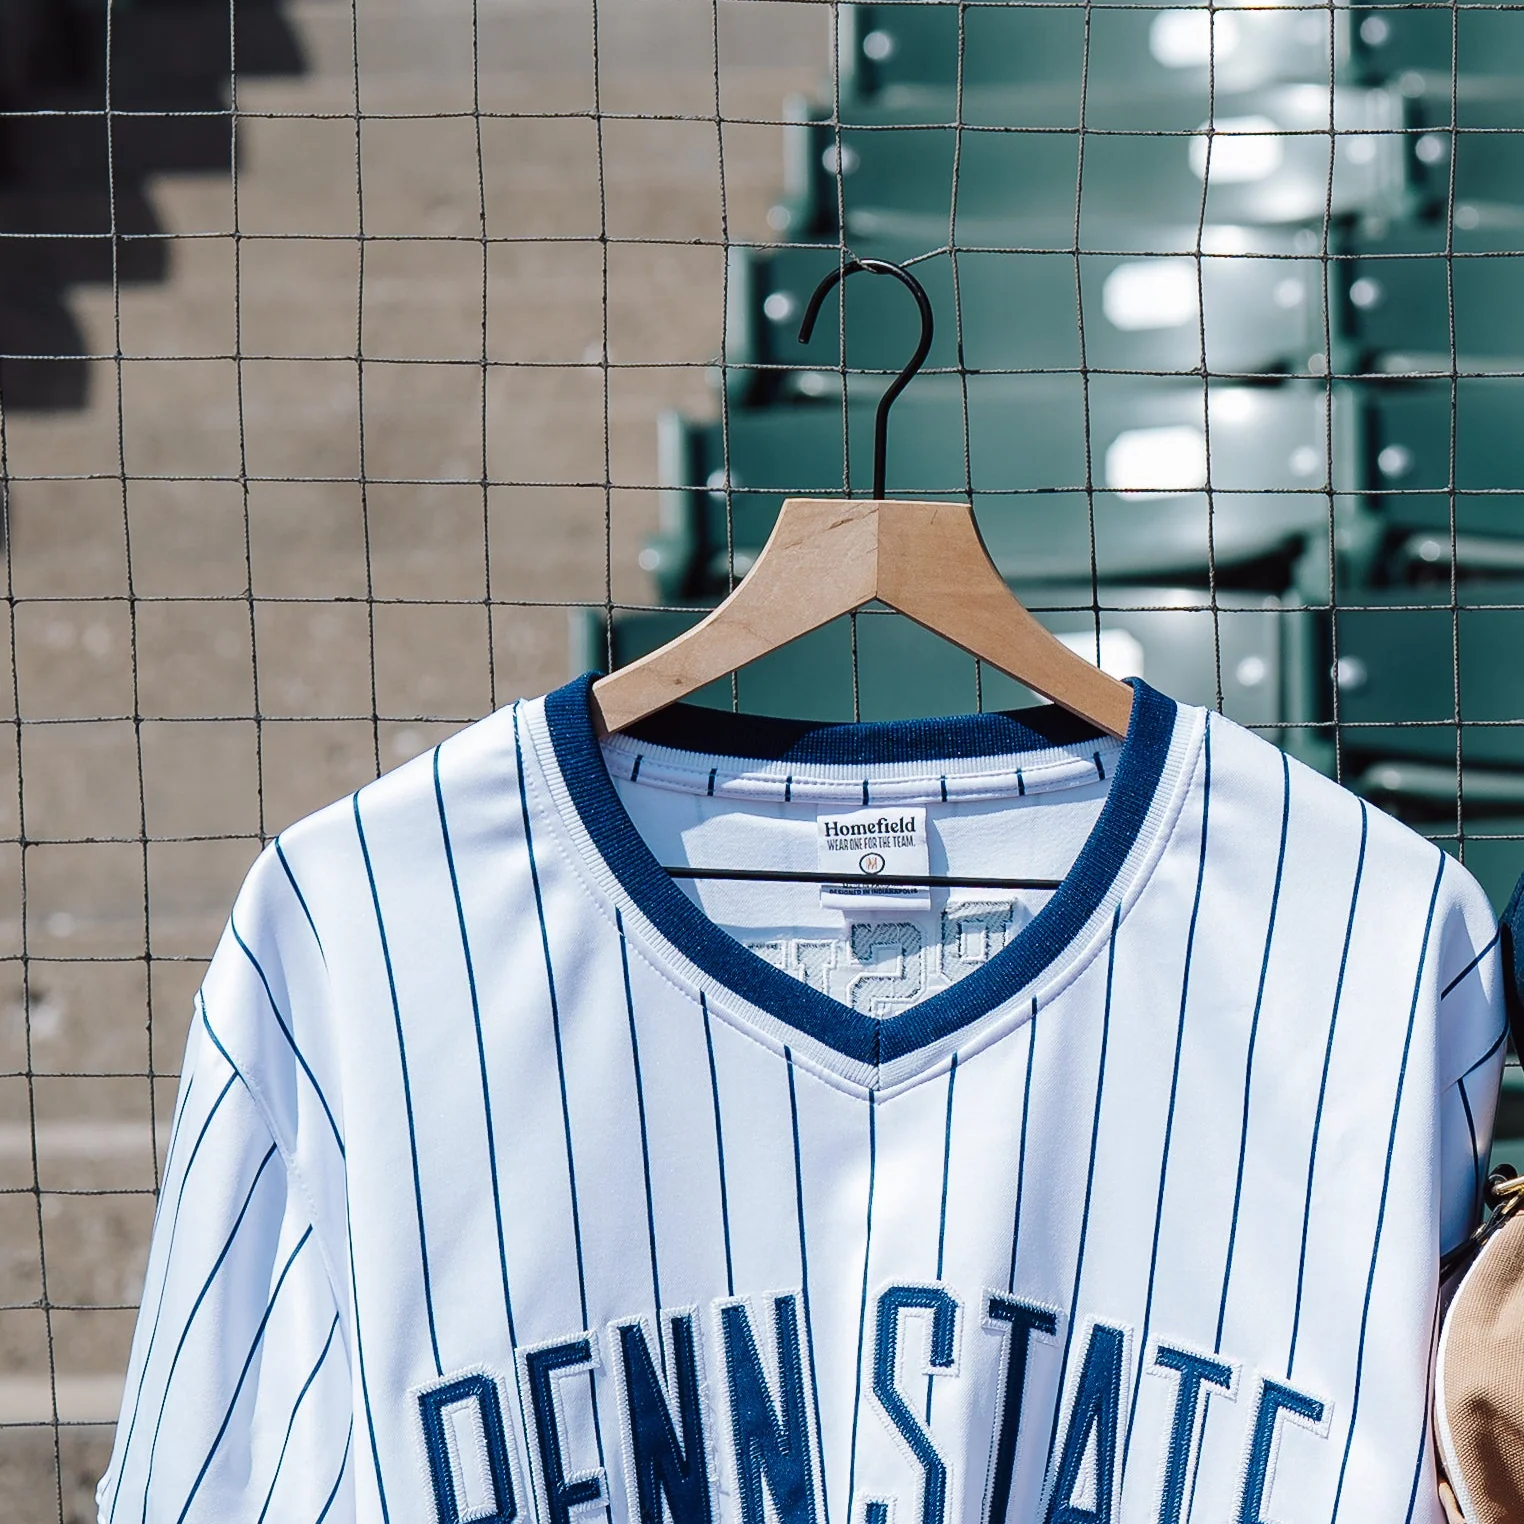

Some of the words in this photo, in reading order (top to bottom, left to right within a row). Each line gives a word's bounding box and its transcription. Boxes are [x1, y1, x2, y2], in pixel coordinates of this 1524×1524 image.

[824, 816, 916, 838] Homefield
[827, 838, 849, 851] WEAR
[850, 837, 863, 851] ONE
[864, 836, 878, 849] FOR
[878, 835, 891, 849] THE
[892, 834, 916, 848] TEAM.
